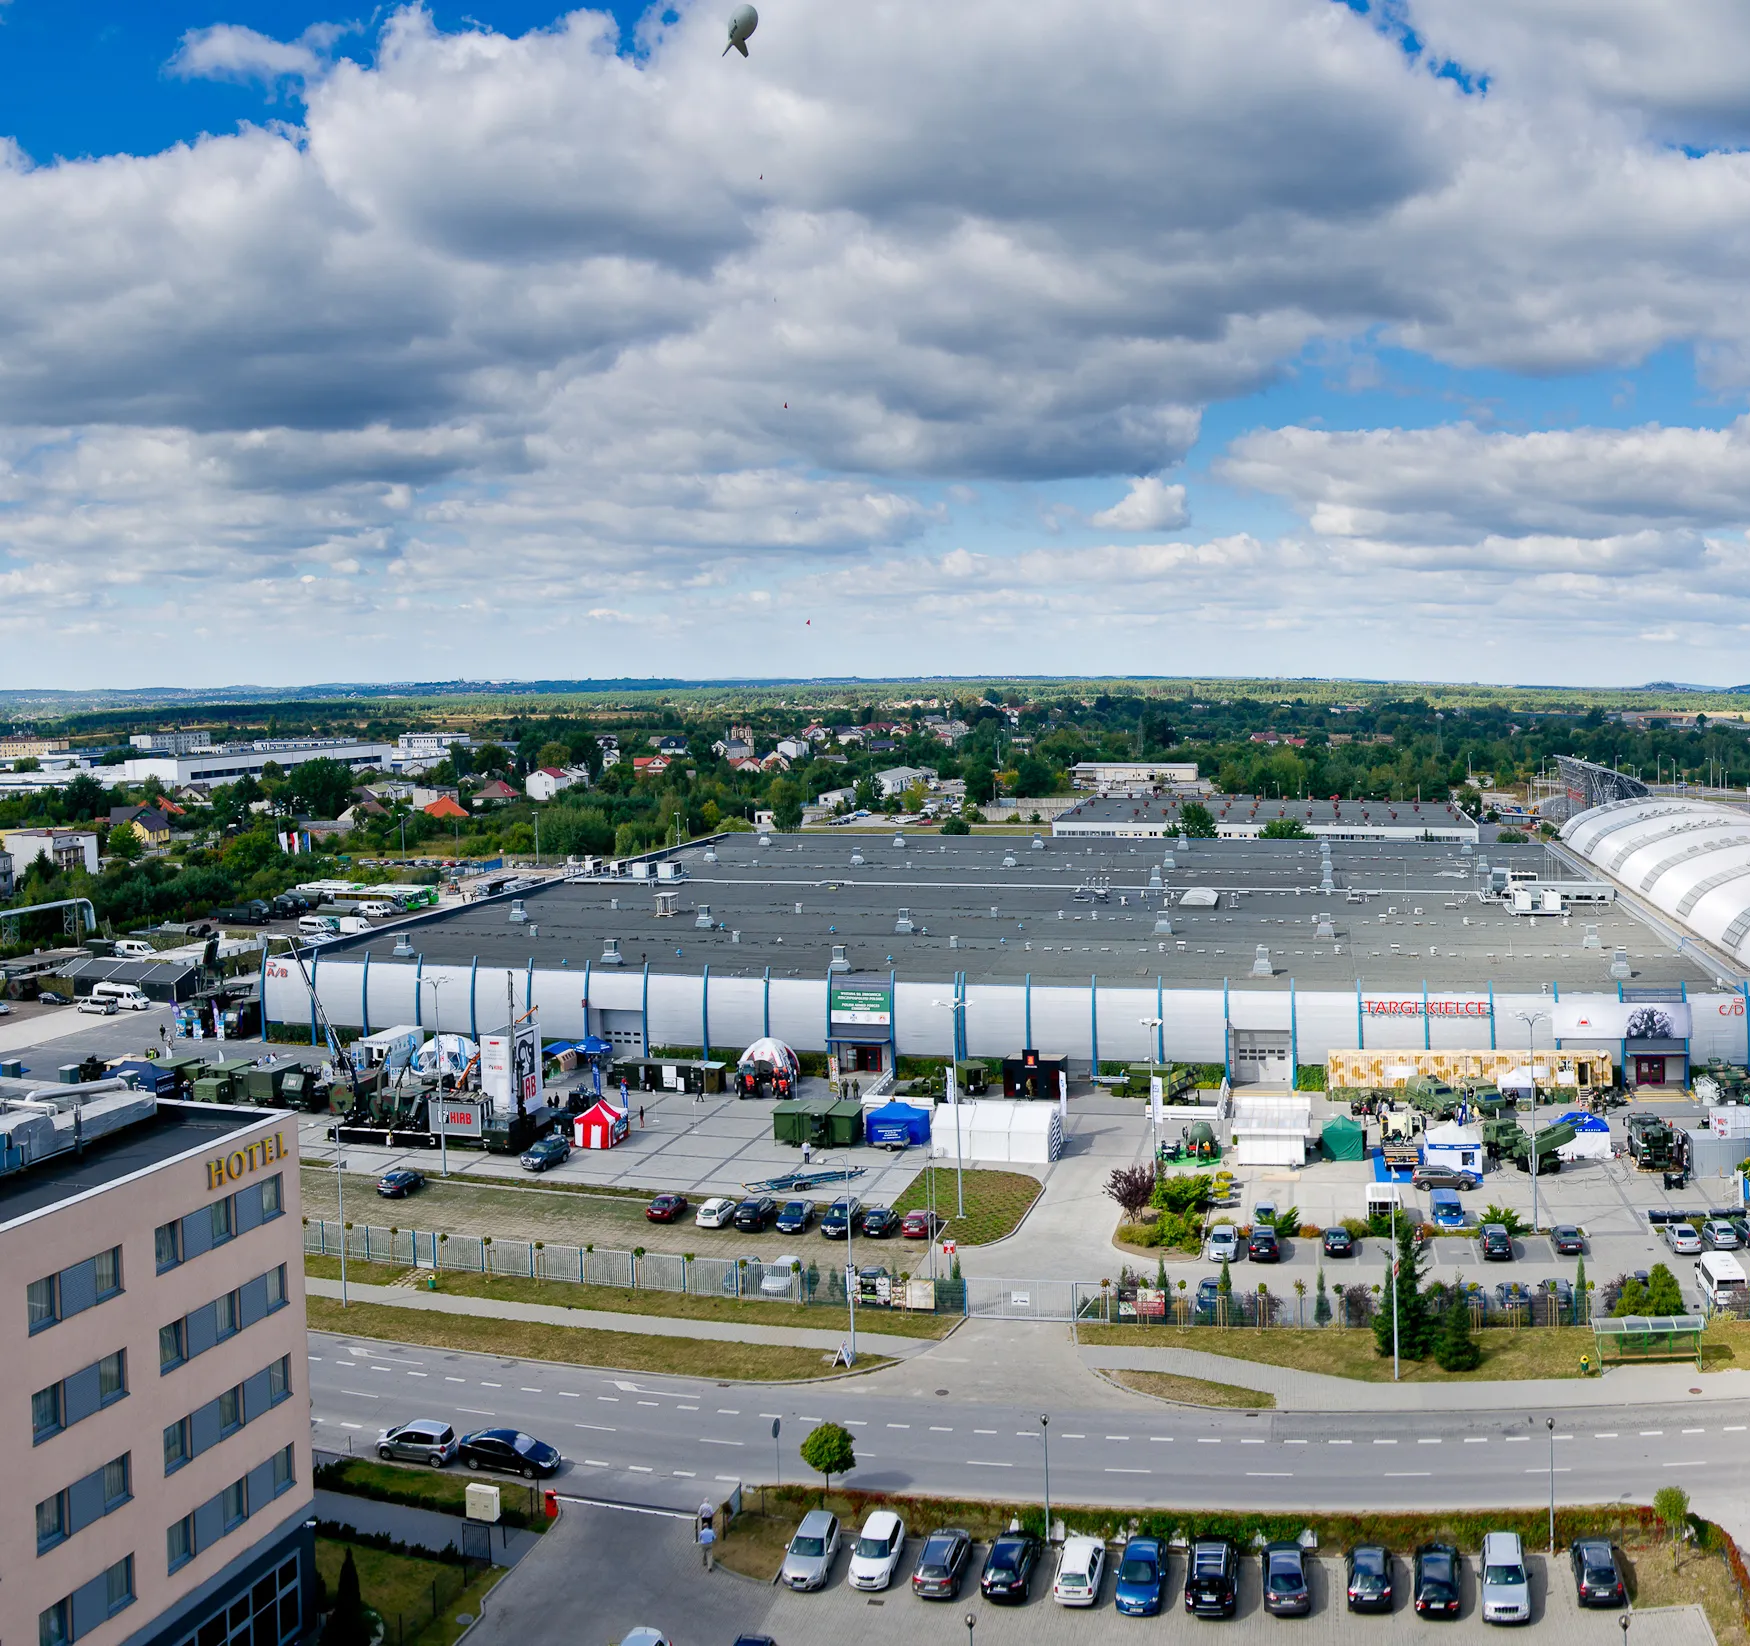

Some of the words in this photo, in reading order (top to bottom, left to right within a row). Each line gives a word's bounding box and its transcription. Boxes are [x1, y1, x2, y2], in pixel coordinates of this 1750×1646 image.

[266, 967, 288, 978] A/B
[1364, 1000, 1419, 1014] TARGI
[1426, 1001, 1487, 1015] KIELCE
[1719, 1003, 1745, 1016] C/D
[206, 1131, 289, 1191] HOTEL
